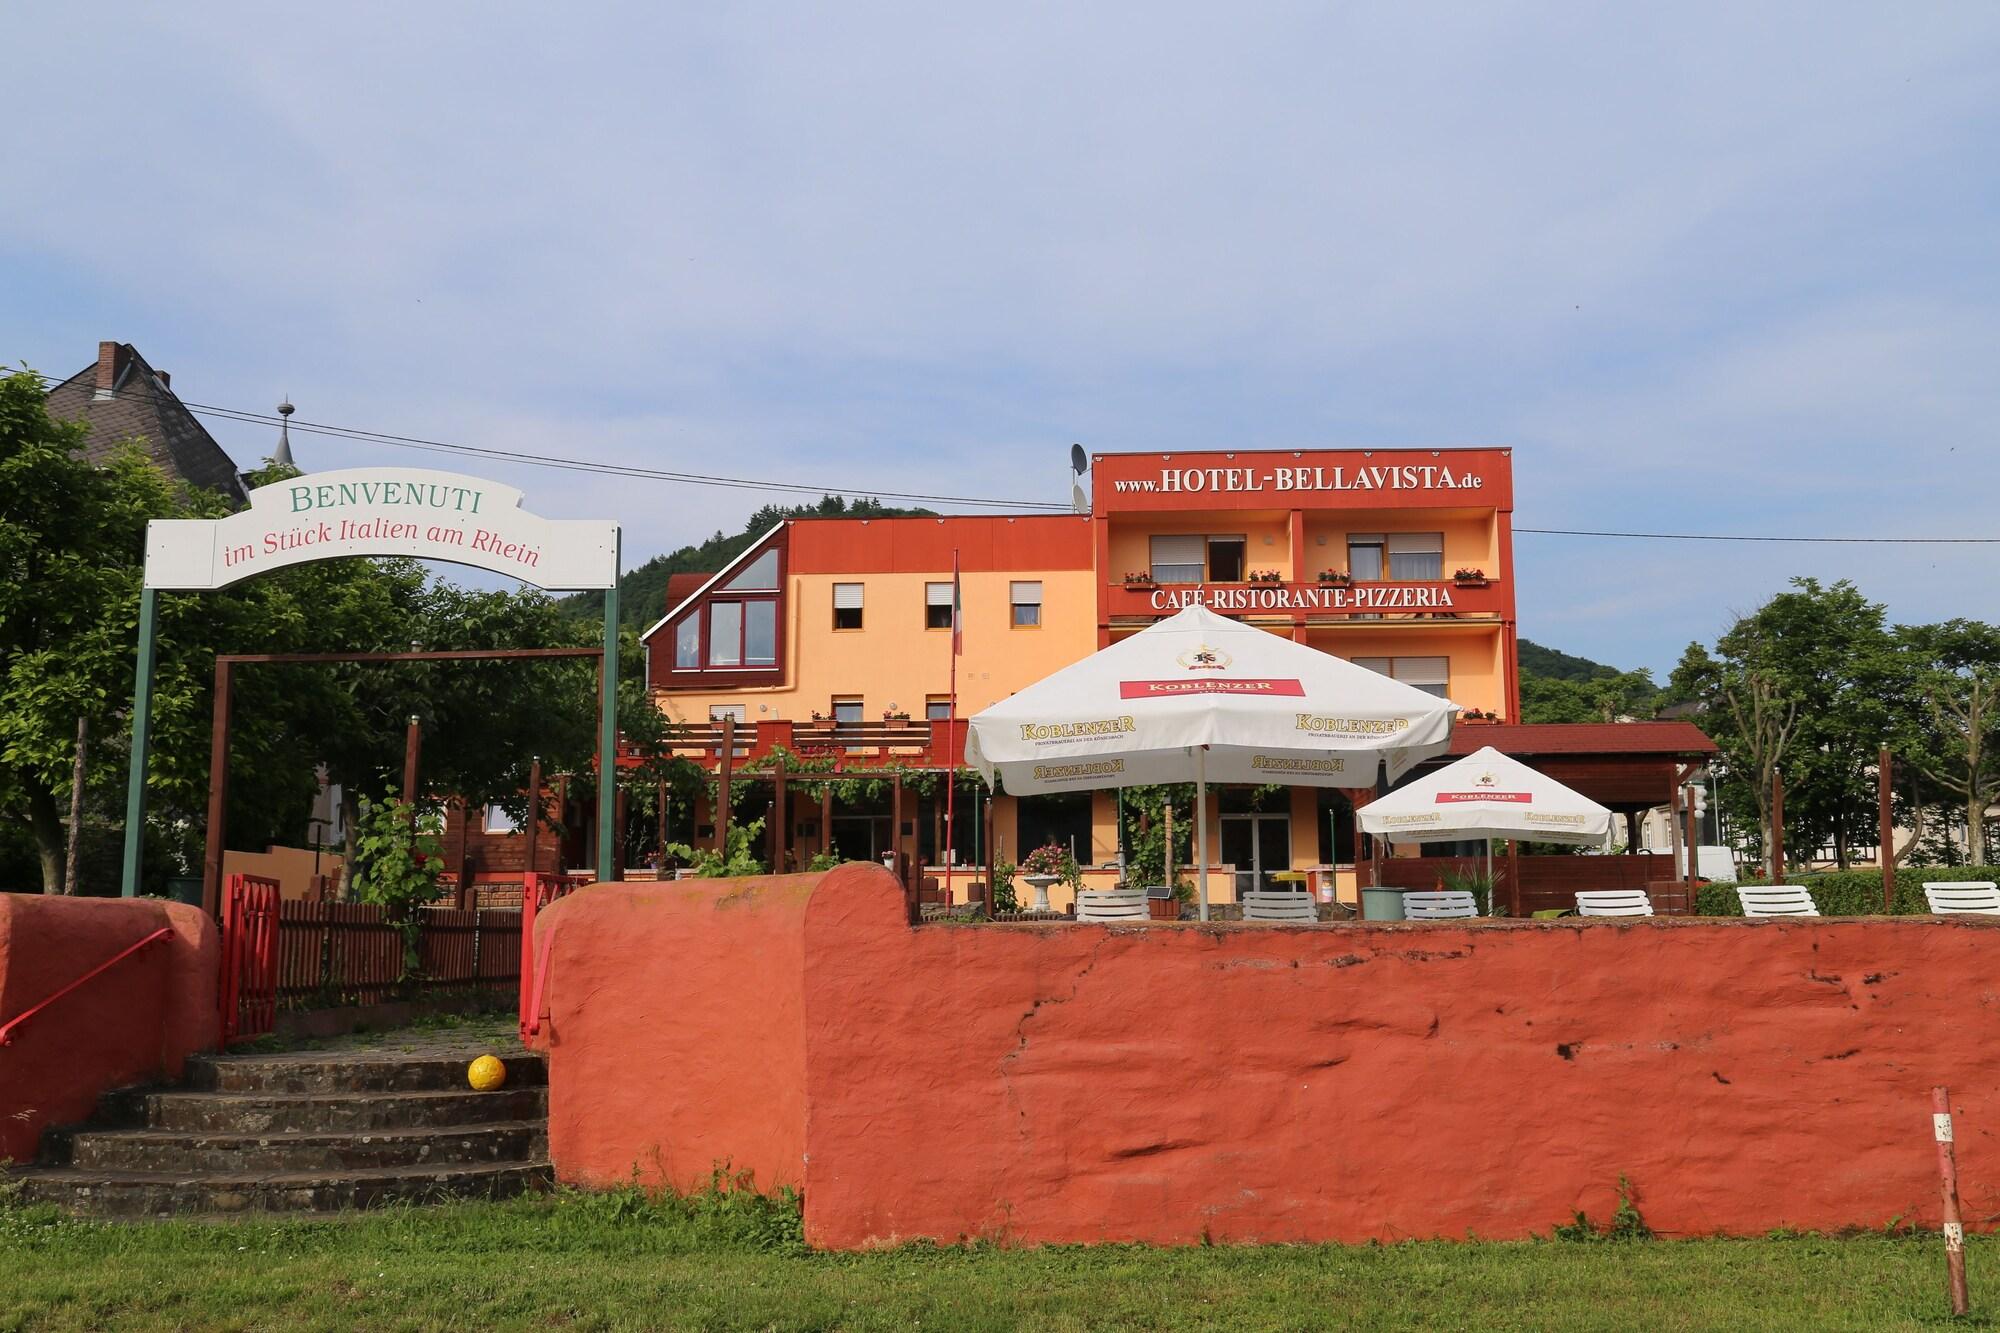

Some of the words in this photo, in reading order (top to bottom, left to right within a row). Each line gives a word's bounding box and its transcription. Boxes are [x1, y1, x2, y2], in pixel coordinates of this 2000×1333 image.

[1114, 466, 1482, 493] www.HOTEL-BELLAVISTA.de
[289, 482, 483, 514] BENVENUTI
[224, 543, 255, 568] im
[263, 522, 332, 555] Stück
[339, 517, 418, 541] Italien
[427, 525, 463, 546] am
[471, 528, 540, 568] Rhein
[1151, 584, 1453, 609] CAFÉ-RISTORANTE-PIZZERIA
[1149, 681, 1273, 691] KOBLENZER
[1020, 715, 1136, 740] KOBLENZER
